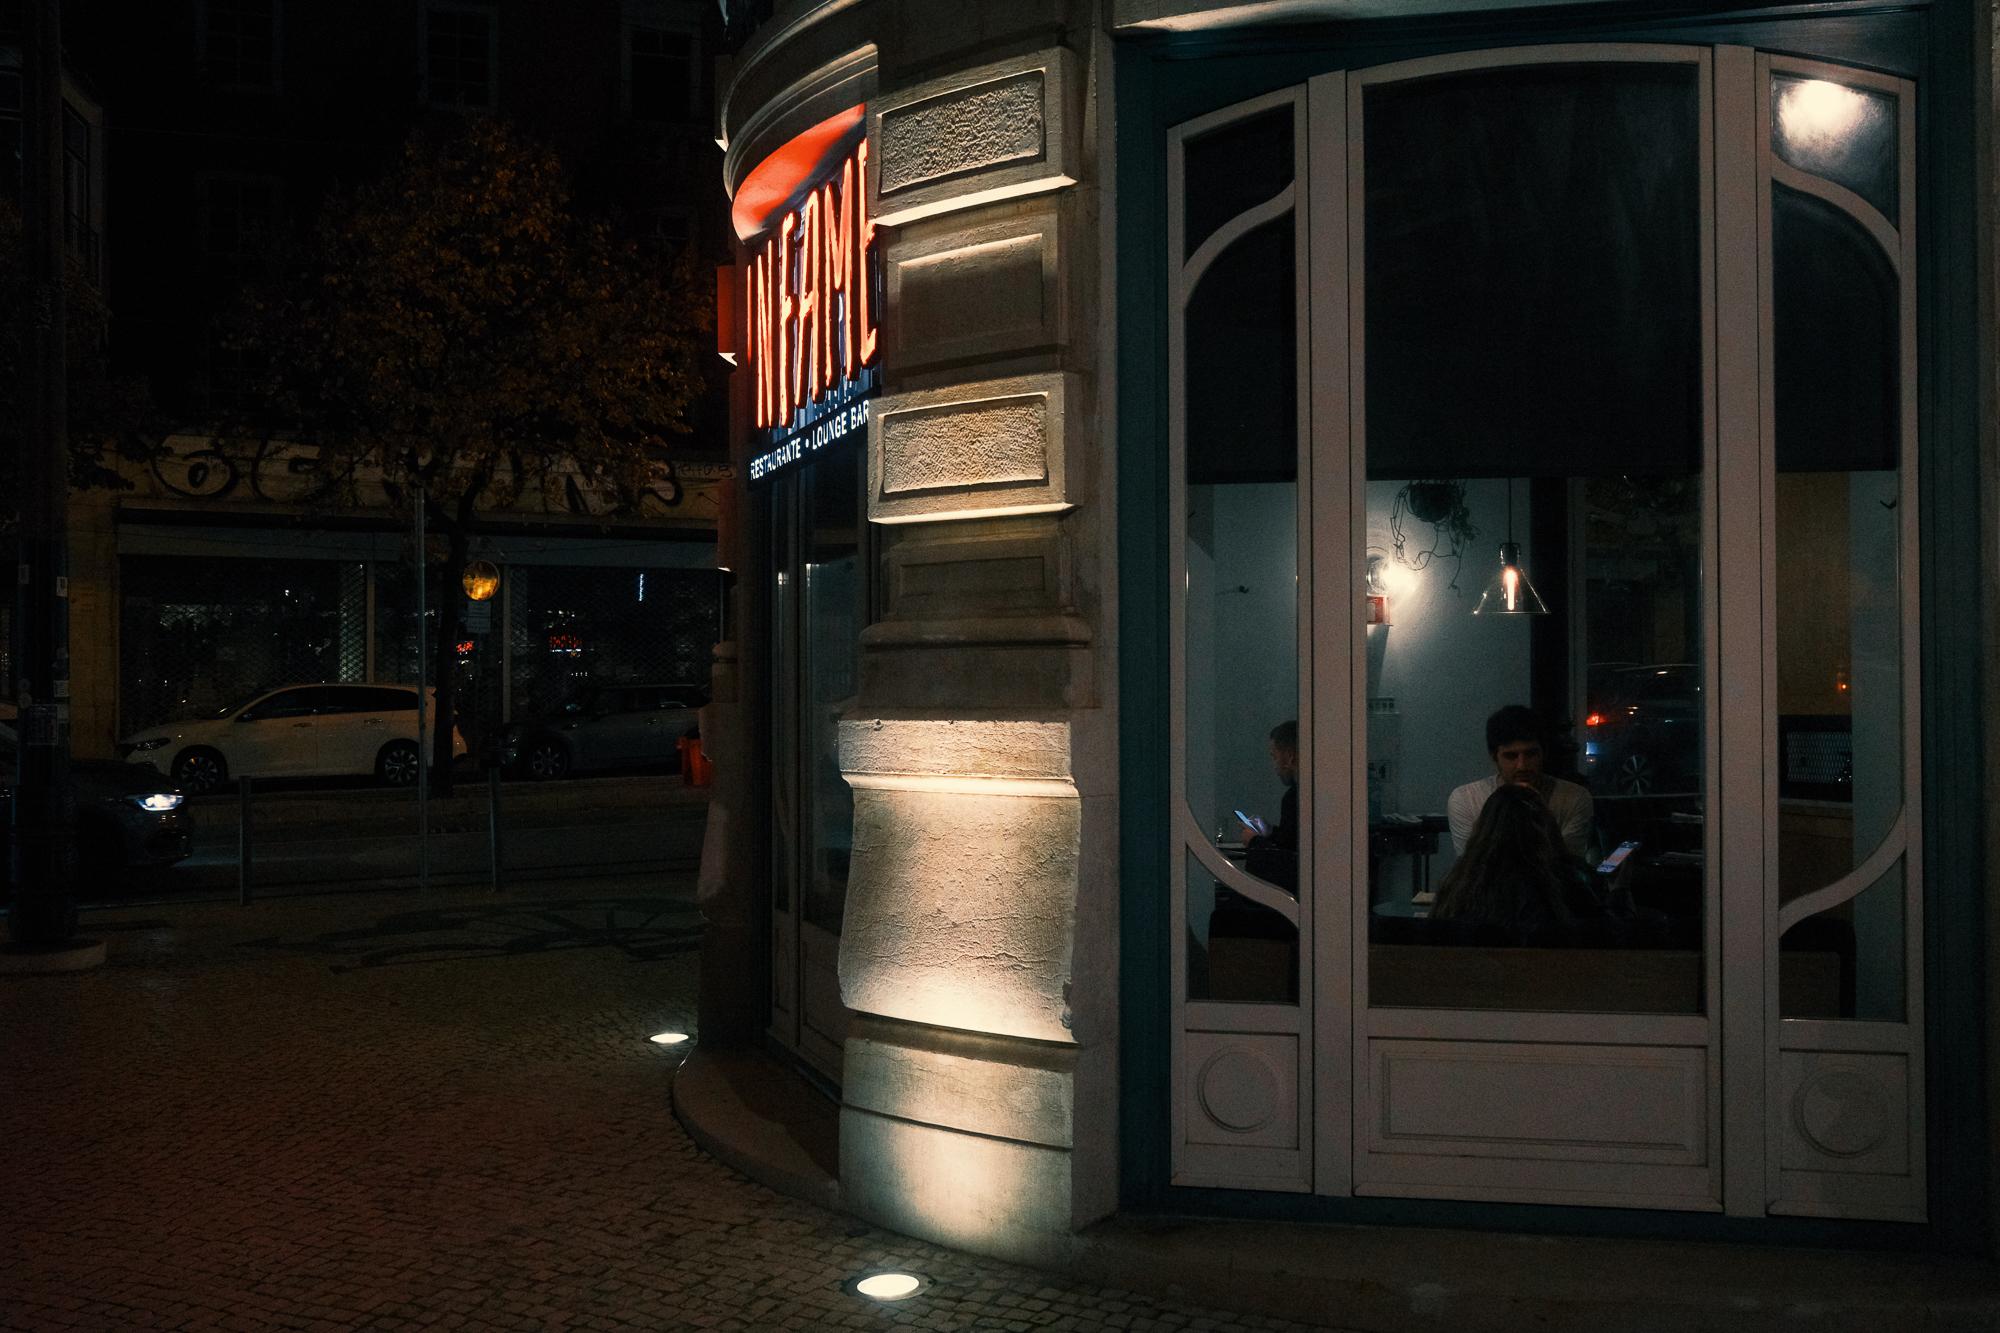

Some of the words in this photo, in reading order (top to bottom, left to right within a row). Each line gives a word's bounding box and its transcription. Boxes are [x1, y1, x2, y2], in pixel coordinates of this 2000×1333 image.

[746, 137, 878, 429] INFAME
[750, 437, 801, 480] RESTAURANTE
[812, 411, 848, 450] LOUNGE
[850, 399, 869, 430] BAR
